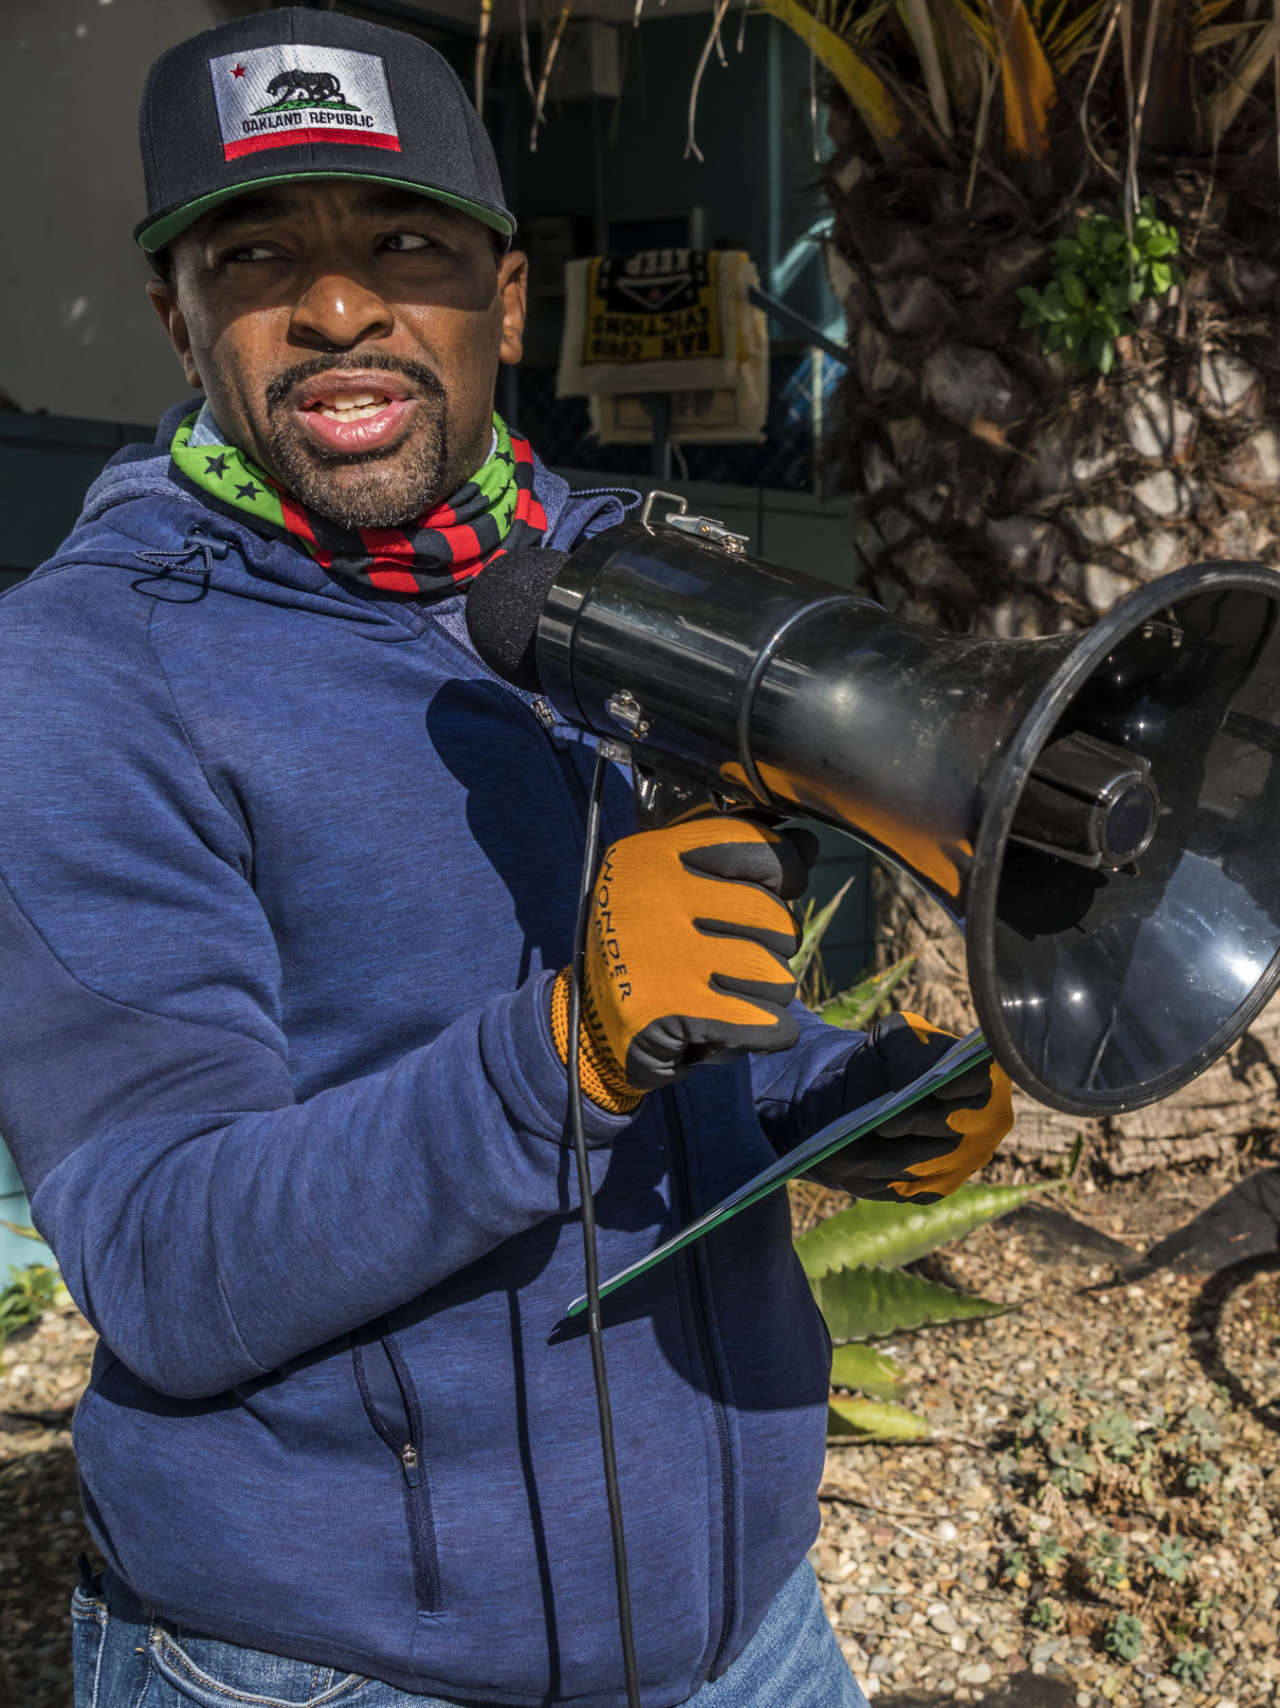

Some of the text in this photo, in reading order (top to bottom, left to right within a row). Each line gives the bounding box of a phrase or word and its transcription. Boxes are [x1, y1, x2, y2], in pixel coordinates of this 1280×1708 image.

[242, 111, 374, 134] OAKLAND REPUBLIC
[593, 306, 710, 335] EVICTIONS
[661, 331, 710, 356] BAN
[598, 848, 632, 1001] WONDER
